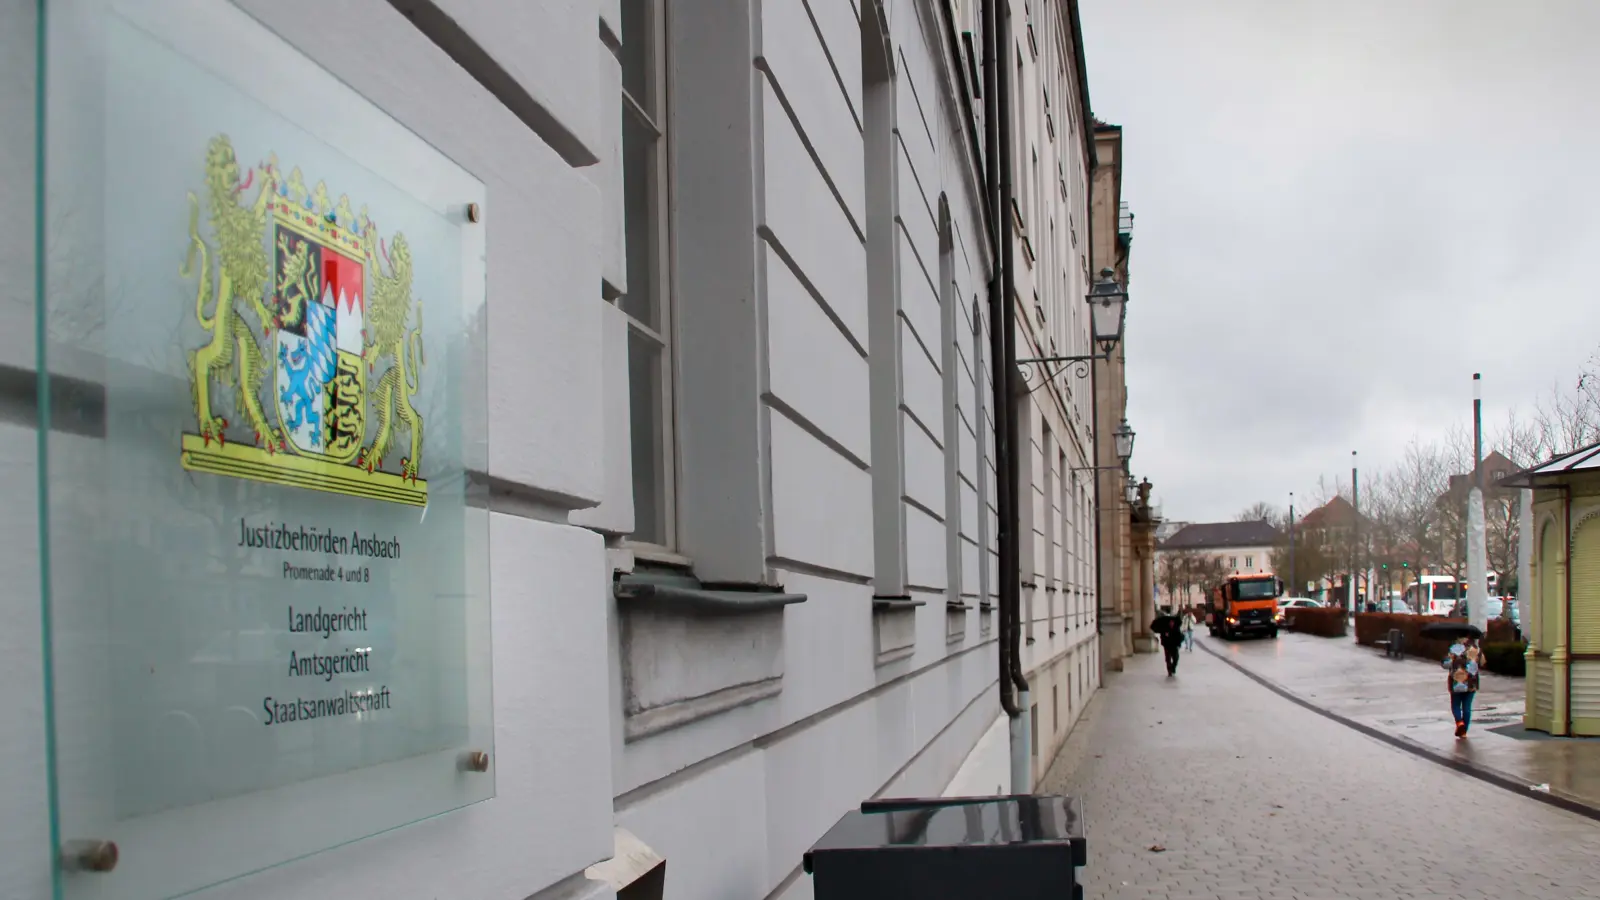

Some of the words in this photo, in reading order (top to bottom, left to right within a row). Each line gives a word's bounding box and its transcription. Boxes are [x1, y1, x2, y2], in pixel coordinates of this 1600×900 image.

[238, 518, 347, 555] Justizbehörden
[351, 531, 400, 559] Ansbach
[283, 562, 335, 582] Promenade
[337, 567, 343, 580] 4
[346, 567, 362, 583] und
[364, 568, 370, 583] 8
[288, 606, 368, 639] Landgericht
[288, 648, 370, 682] Amtsgericht
[263, 685, 391, 725] Staatsanwaltschaft
